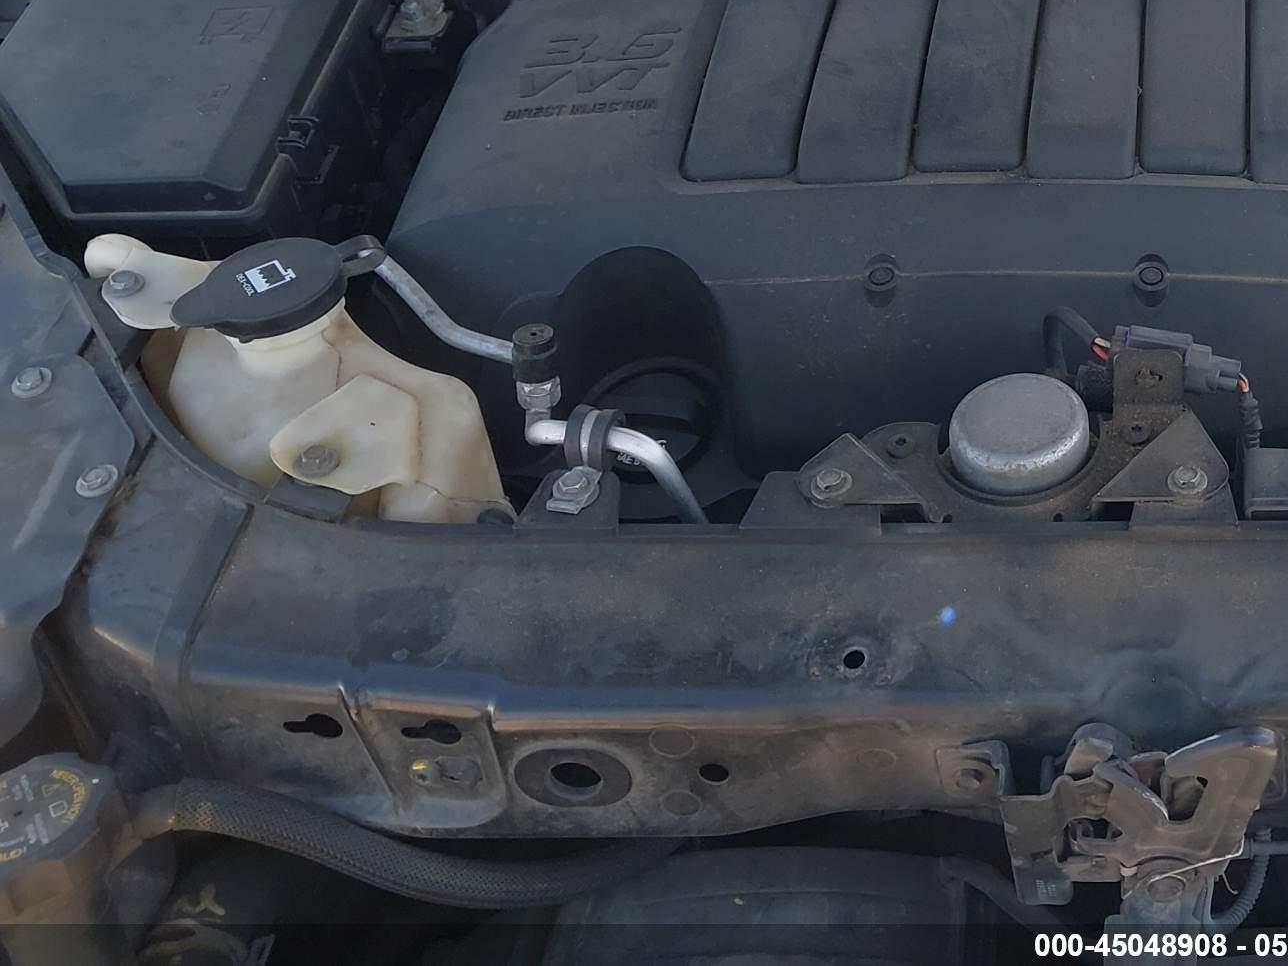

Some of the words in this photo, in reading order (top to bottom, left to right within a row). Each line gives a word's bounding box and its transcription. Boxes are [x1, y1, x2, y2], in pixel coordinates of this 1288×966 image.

[523, 27, 682, 69] 3.6
[519, 62, 670, 98] VVT
[503, 104, 567, 121] DIRECT
[568, 97, 659, 117] INJECTION
